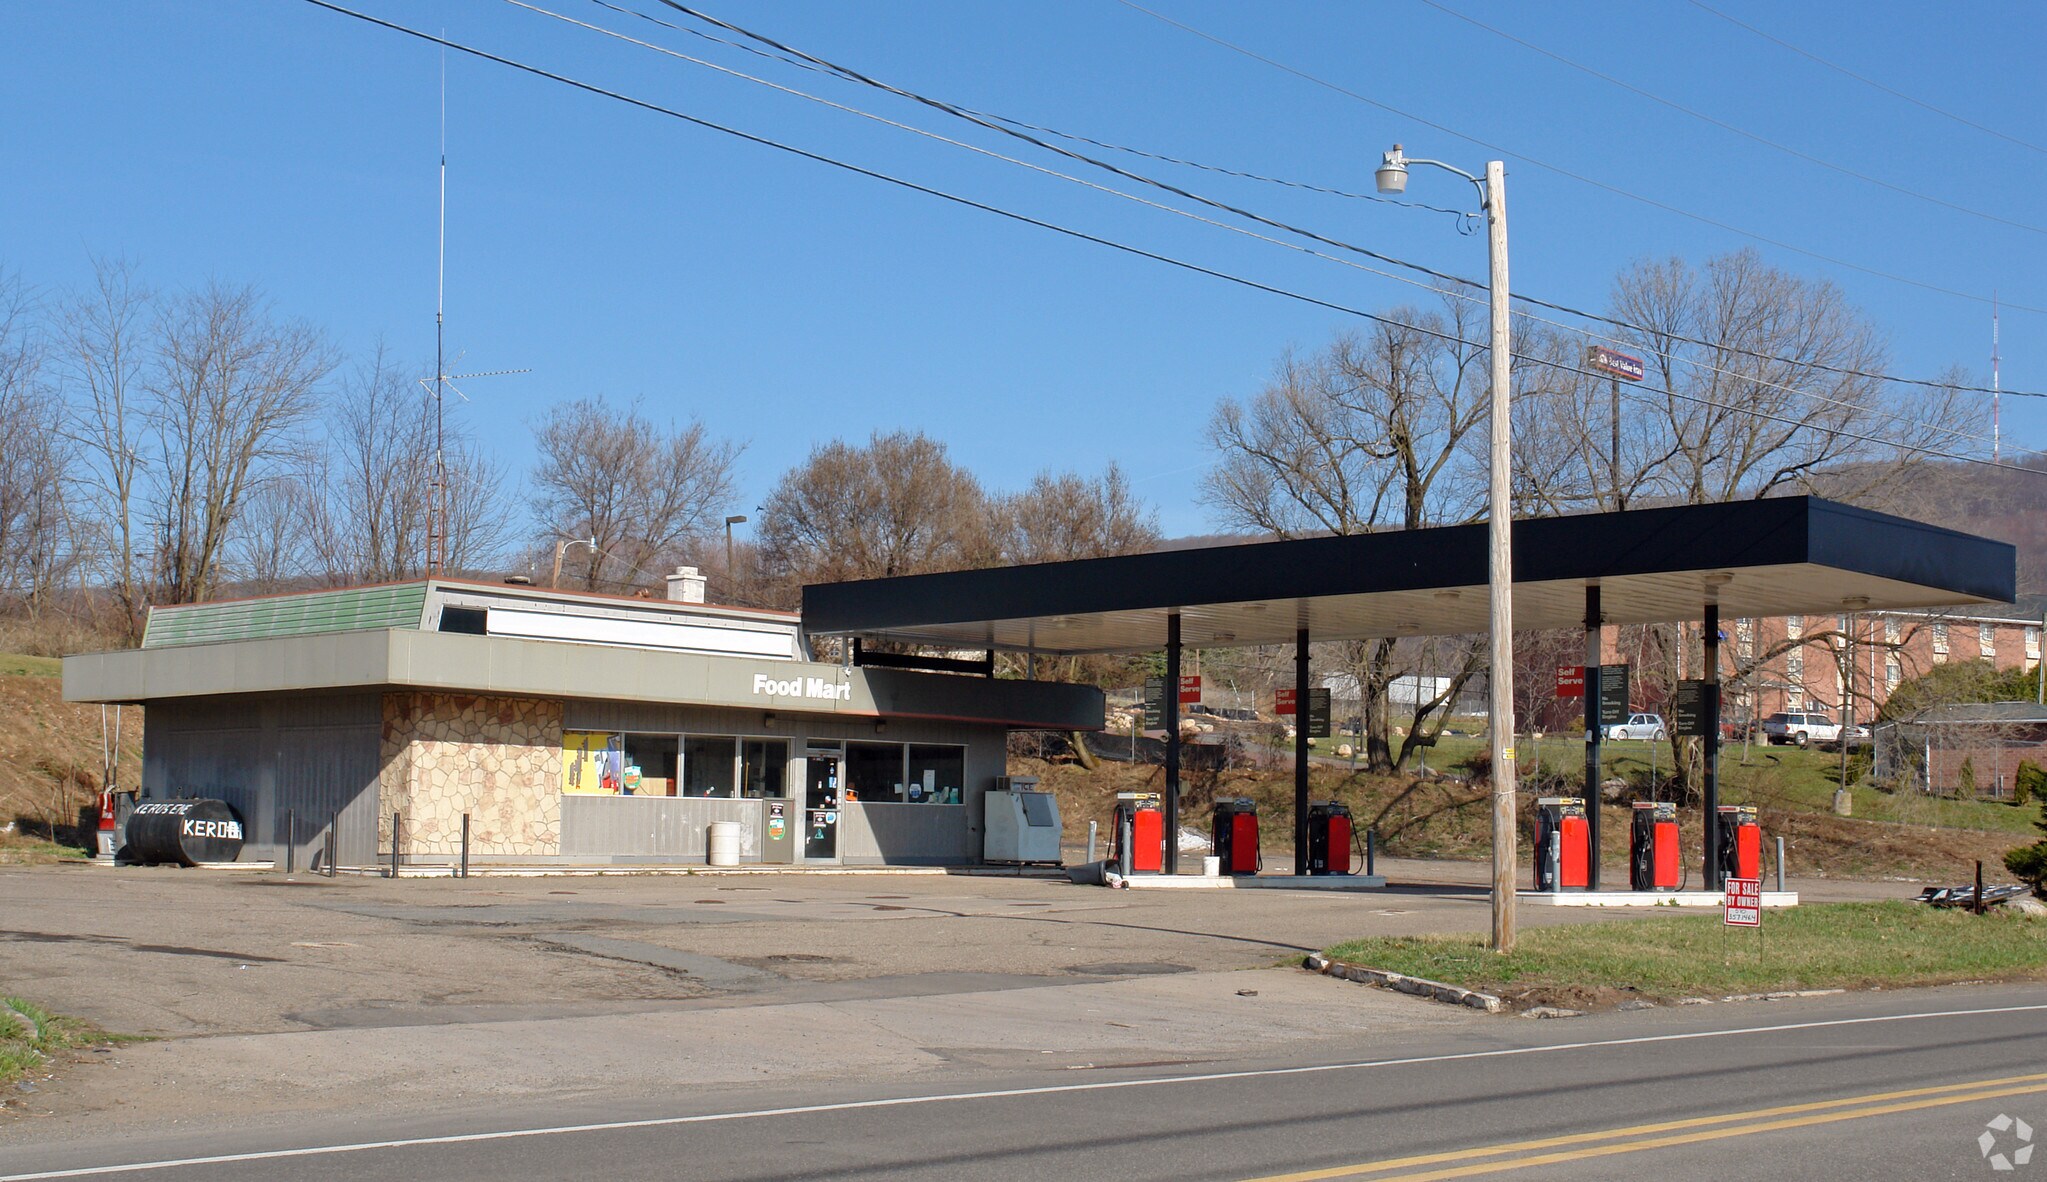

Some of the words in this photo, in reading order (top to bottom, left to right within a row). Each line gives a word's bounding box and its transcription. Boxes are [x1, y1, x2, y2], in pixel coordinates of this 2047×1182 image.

[1558, 668, 1575, 676] Self
[1180, 677, 1194, 685] Self
[1558, 677, 1583, 685] Serve
[753, 673, 803, 697] Food
[805, 677, 851, 700] Mart
[1180, 685, 1200, 693] Serve
[134, 803, 193, 815] KEROSENE
[1727, 881, 1740, 894] FOR
[1742, 882, 1758, 895] SALE
[1727, 896, 1735, 906] BY
[1737, 896, 1759, 907] OWNER
